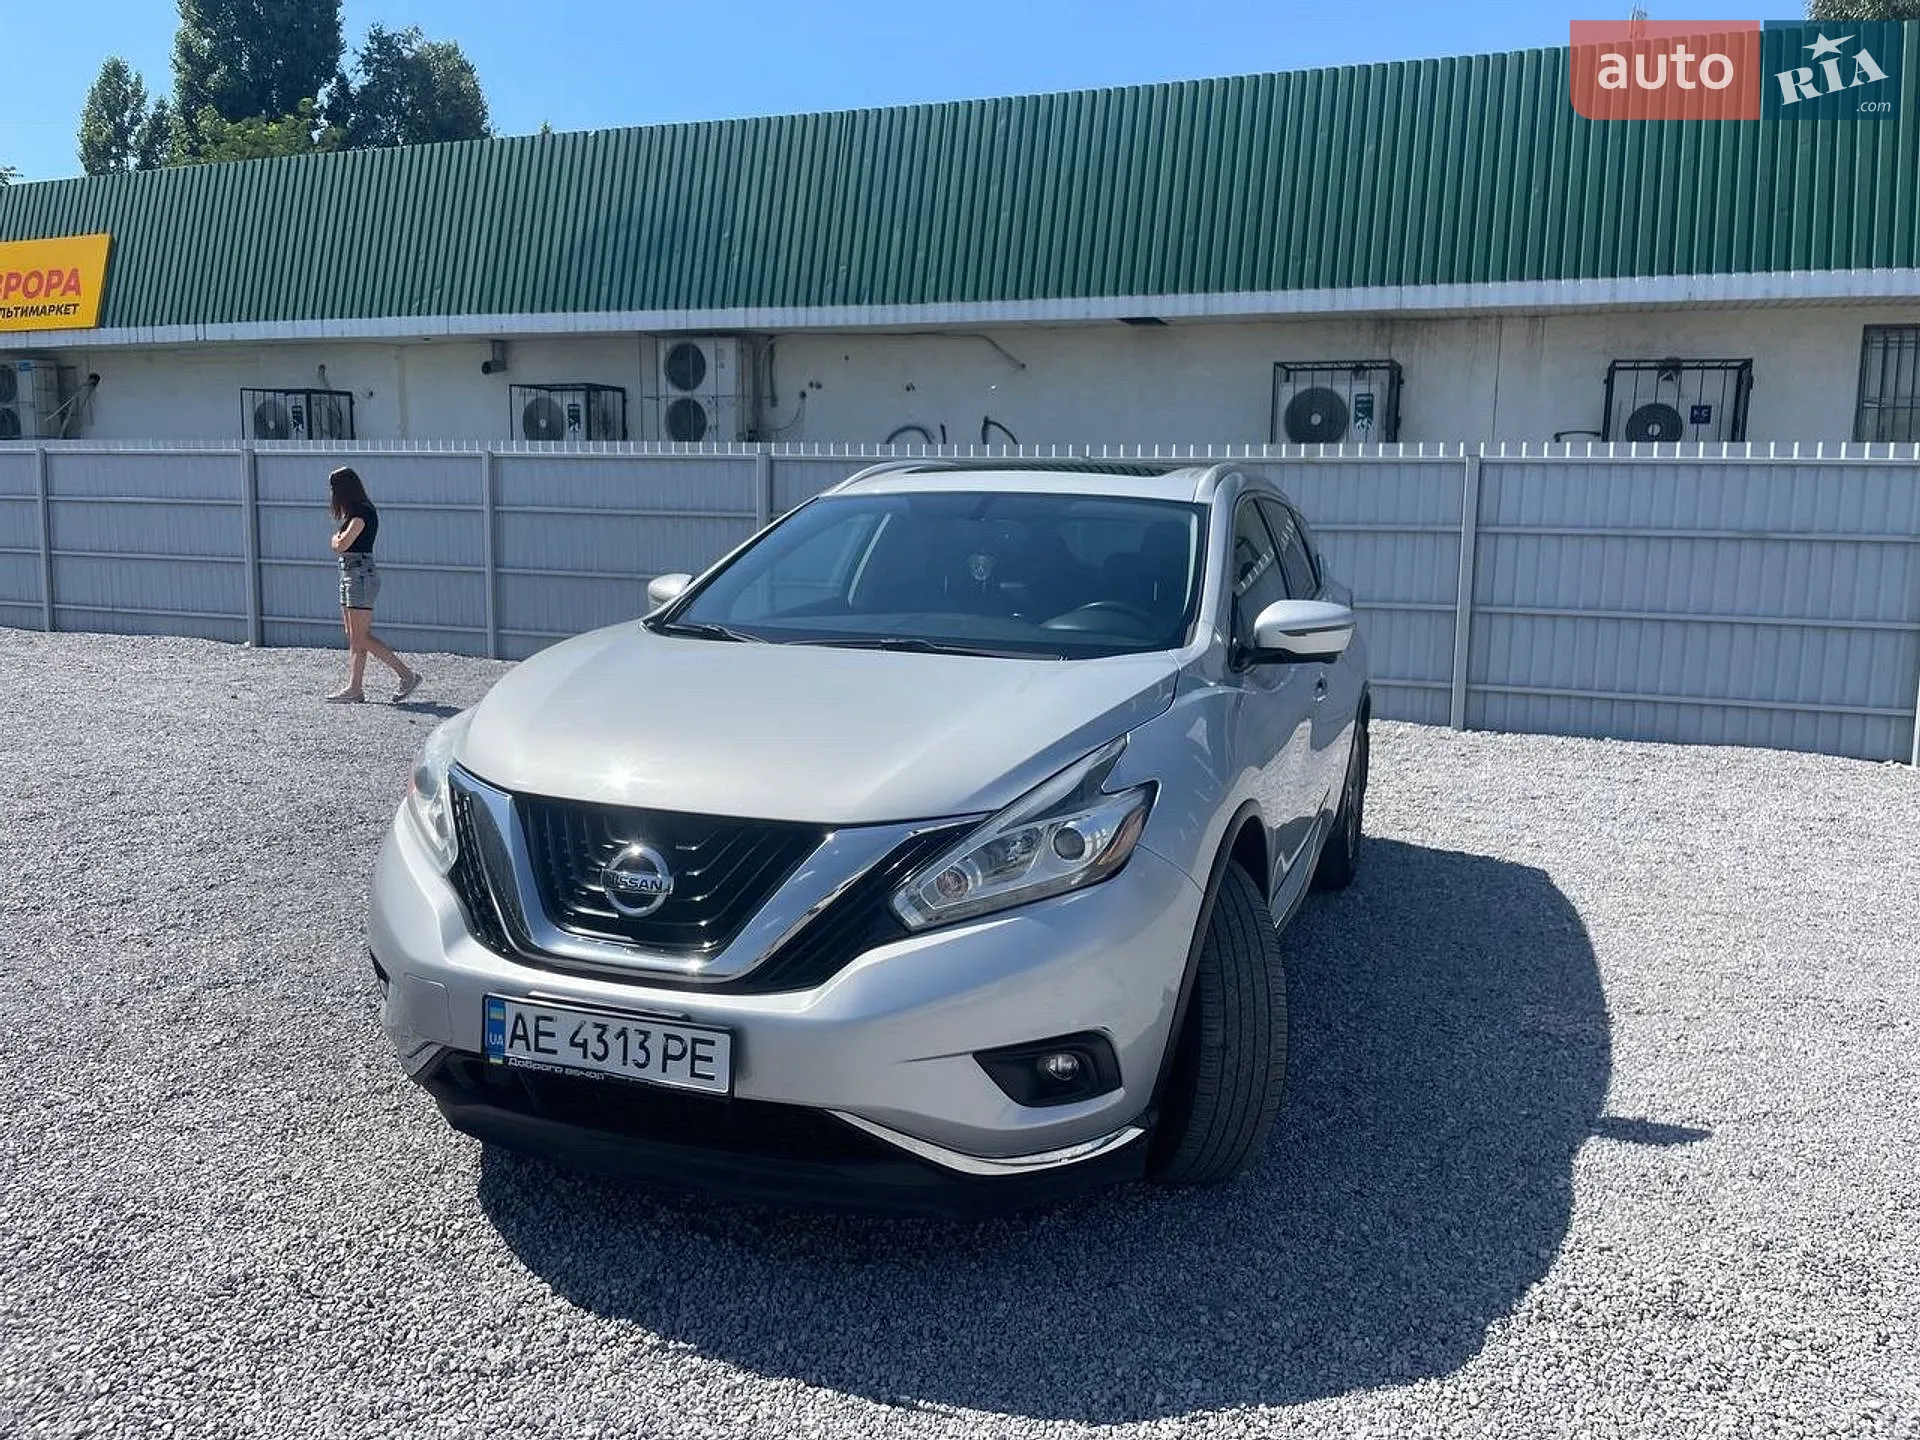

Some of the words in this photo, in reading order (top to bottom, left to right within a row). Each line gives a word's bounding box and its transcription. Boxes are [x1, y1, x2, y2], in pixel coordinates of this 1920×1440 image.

[0, 267, 82, 301] РОРА
[607, 871, 663, 890] NISSAN
[489, 1032, 504, 1046] UA
[508, 1011, 558, 1056] AE
[568, 1020, 652, 1070] 4313
[661, 1032, 716, 1081] PE
